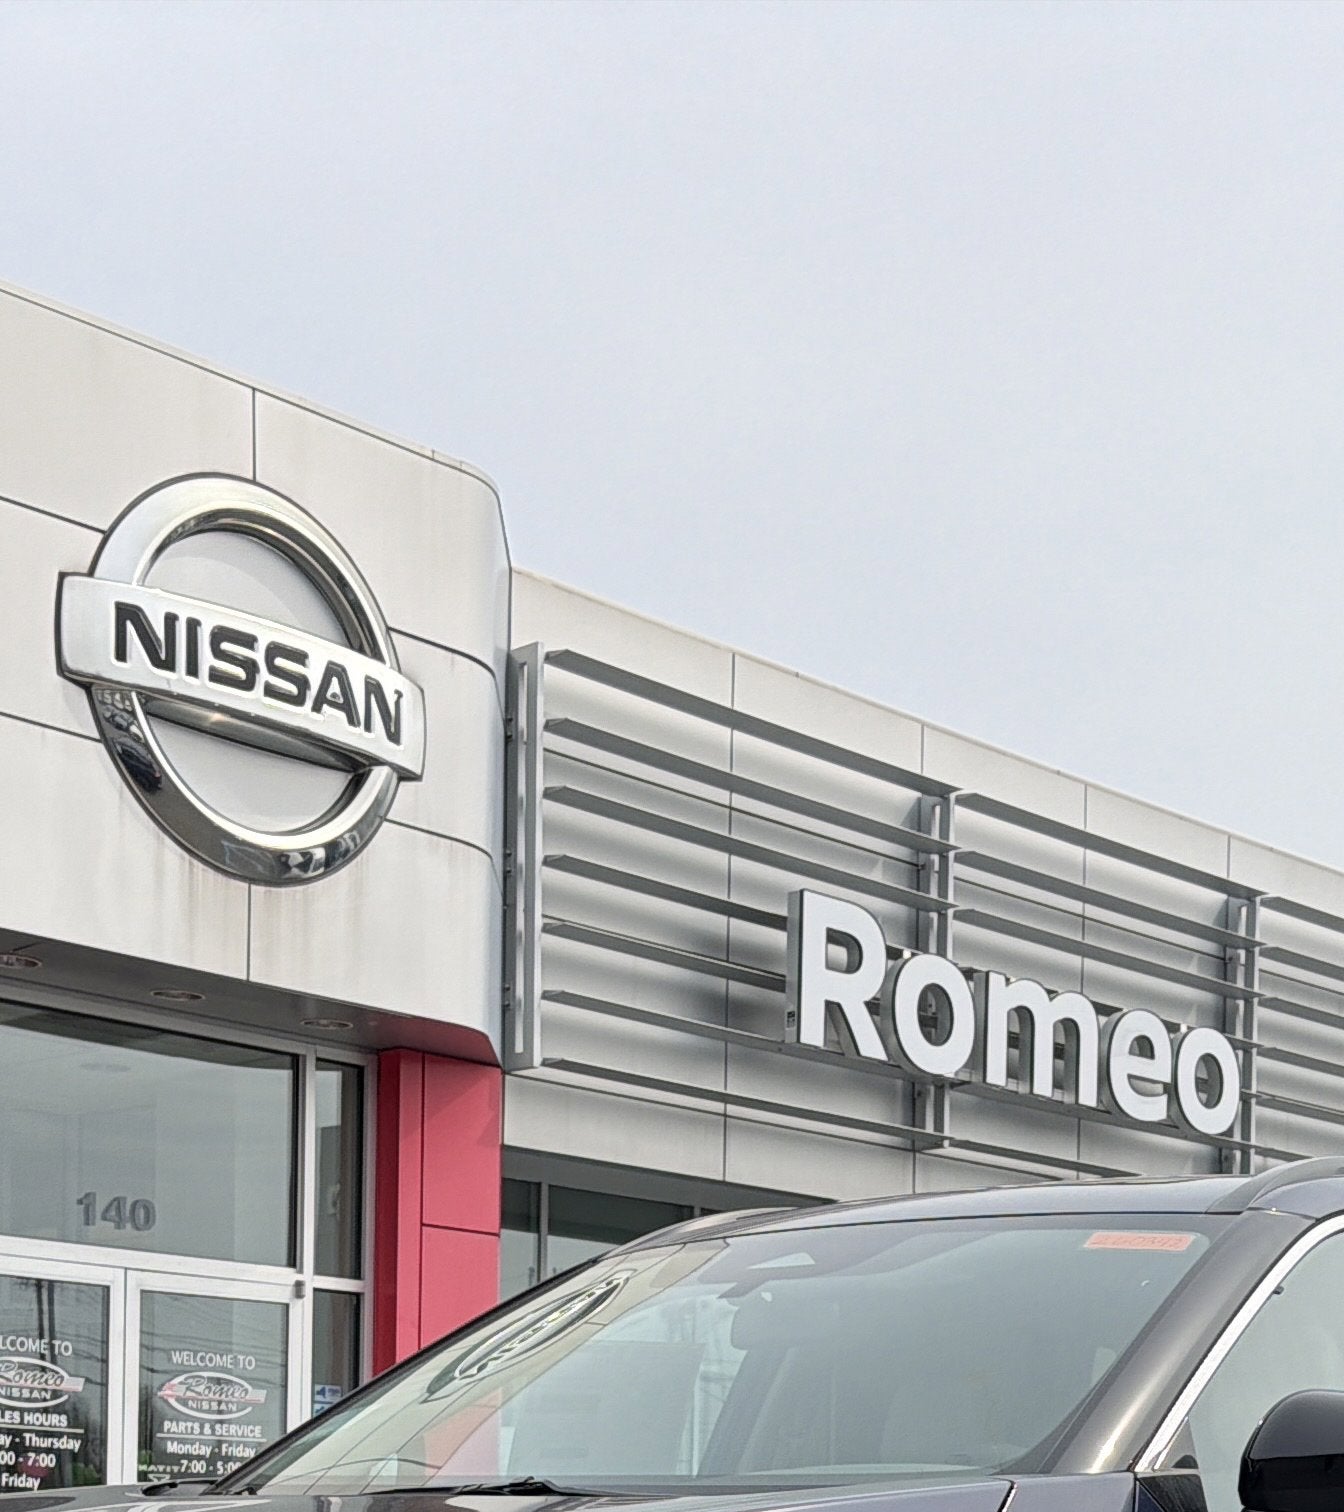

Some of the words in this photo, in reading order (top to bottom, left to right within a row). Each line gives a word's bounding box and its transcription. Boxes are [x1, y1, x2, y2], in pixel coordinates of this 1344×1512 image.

[114, 601, 403, 748] NISSAN
[787, 889, 1241, 1135] Romeo
[77, 1191, 156, 1231] 140
[53, 1341, 73, 1356] TO
[171, 1350, 234, 1369] WELCOME
[237, 1355, 256, 1370] TO
[177, 1375, 249, 1400] Romeo
[188, 1399, 237, 1411] NISSAN
[23, 1411, 68, 1427] HOURS
[163, 1420, 201, 1434] PARTS
[203, 1423, 212, 1435] &
[215, 1424, 262, 1437] SERVICE
[22, 1432, 82, 1452] Thursday
[167, 1441, 212, 1458] Monday
[221, 1443, 256, 1458] Friday
[27, 1452, 56, 1467] 7:00
[180, 1460, 206, 1474] 7:00
[0, 1473, 41, 1492] Friday
